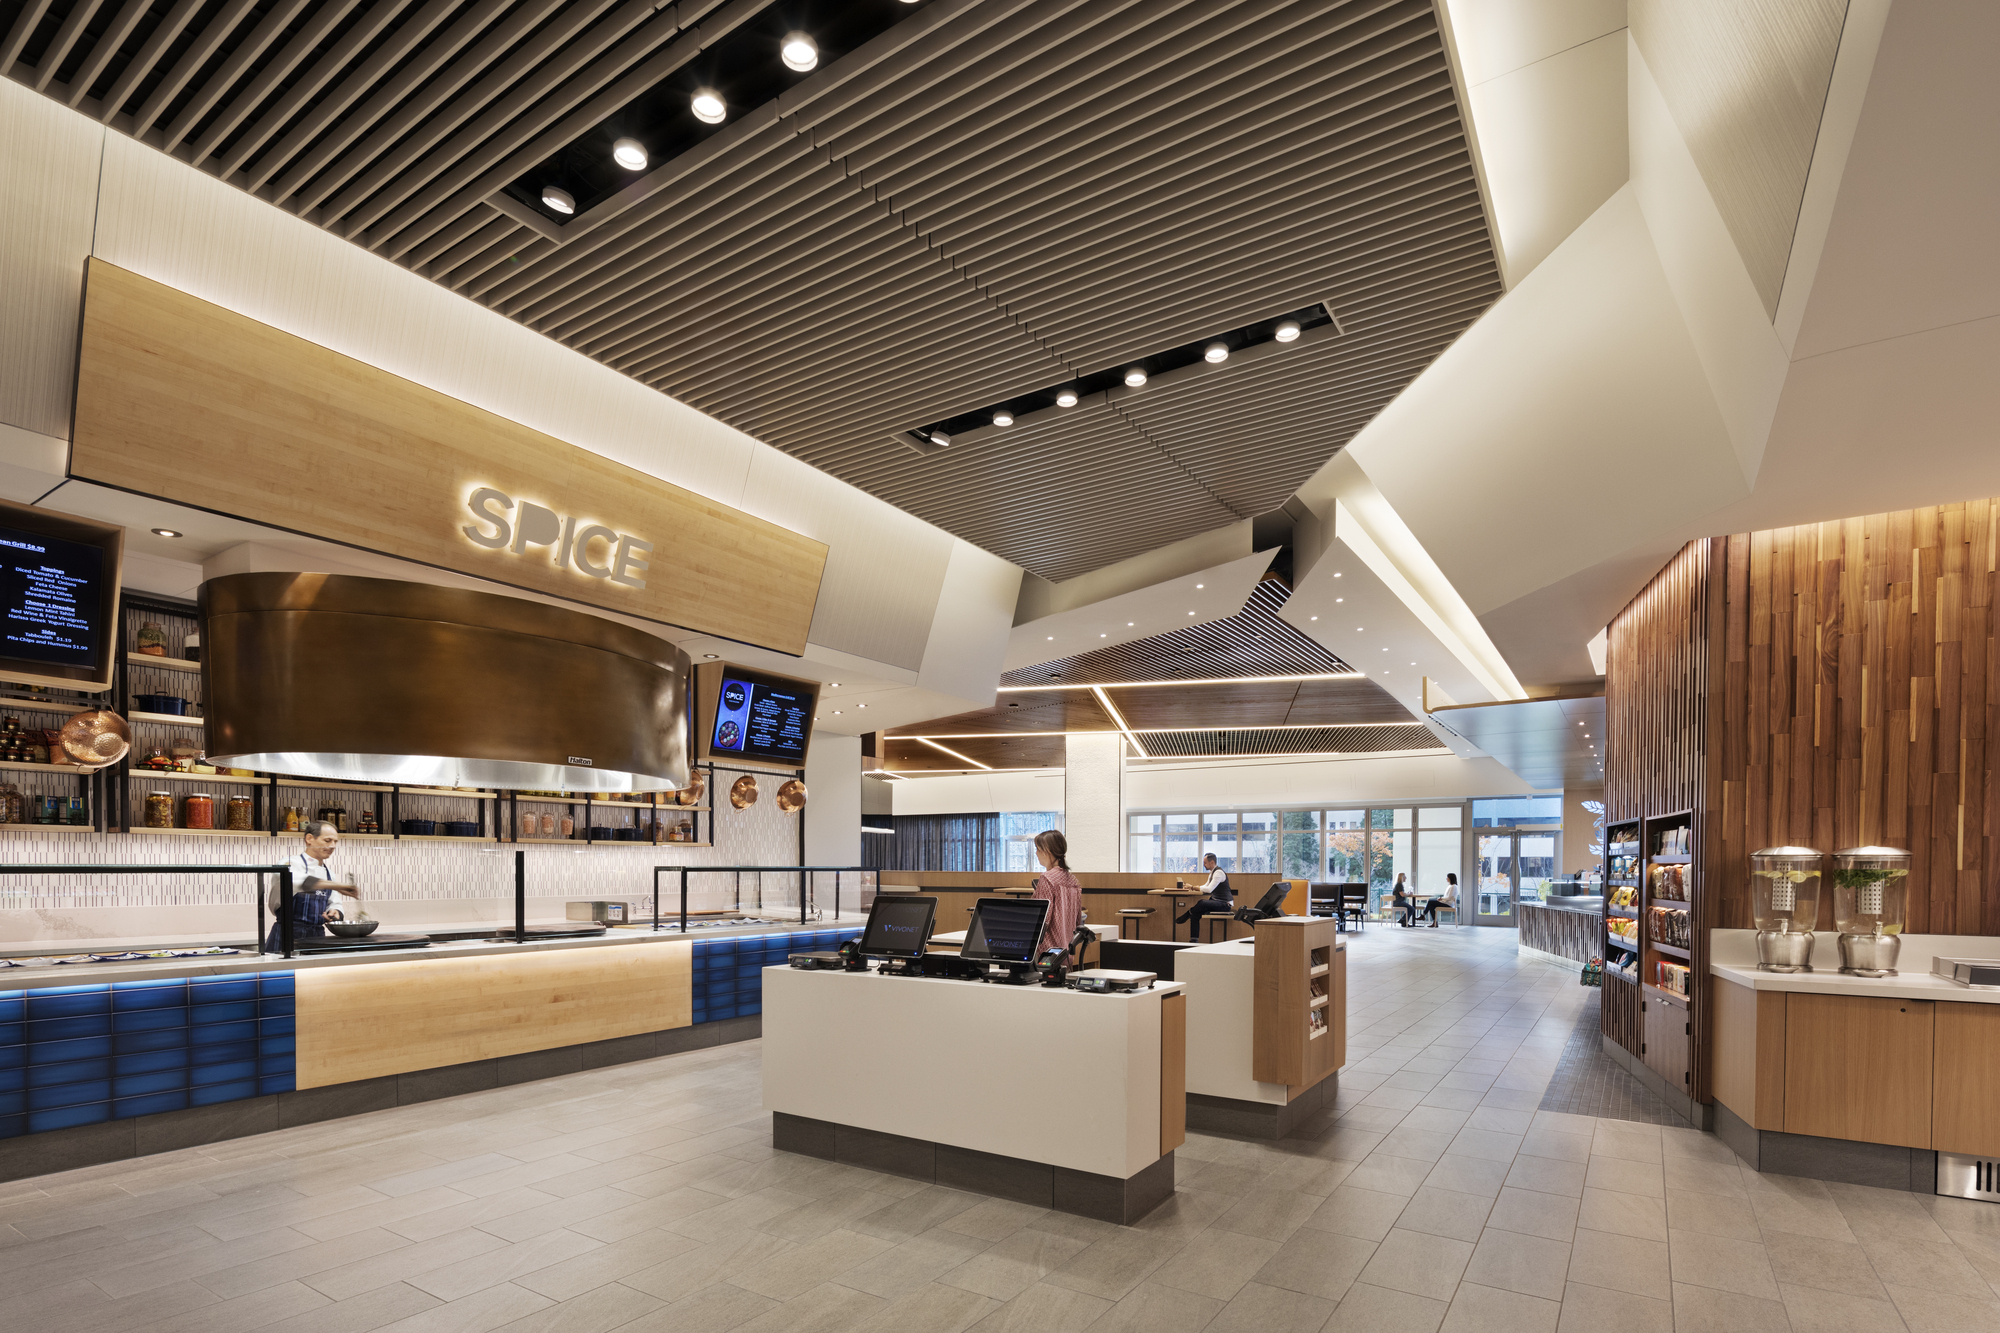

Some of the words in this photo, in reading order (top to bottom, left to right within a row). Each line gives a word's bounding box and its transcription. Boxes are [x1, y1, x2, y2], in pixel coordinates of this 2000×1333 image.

[462, 487, 654, 590] SPICE
[11, 541, 27, 549] Grill
[15, 566, 32, 574] Diced
[33, 569, 54, 578] Tomato
[60, 575, 88, 584] Cucumber
[40, 565, 65, 575] Toppings
[26, 574, 44, 582] Sliced
[57, 579, 77, 587] Onions
[29, 586, 56, 595] Kalamata
[56, 590, 73, 598] Olives
[48, 583, 68, 592] Cheese
[24, 590, 52, 600] Shredded
[52, 595, 77, 604] Romaine
[24, 605, 44, 613] Lemon
[25, 599, 46, 608] Choose
[51, 604, 76, 613] Dressing
[7, 613, 29, 621] Harissa
[29, 616, 47, 624] Greek
[47, 619, 66, 627] Yogurt
[66, 622, 90, 631] Dressing
[41, 629, 57, 637] Sides
[725, 691, 744, 702] SPICE
[569, 757, 592, 765] Halton
[891, 925, 920, 933] VIVONET
[992, 940, 1025, 948] VIVONET
